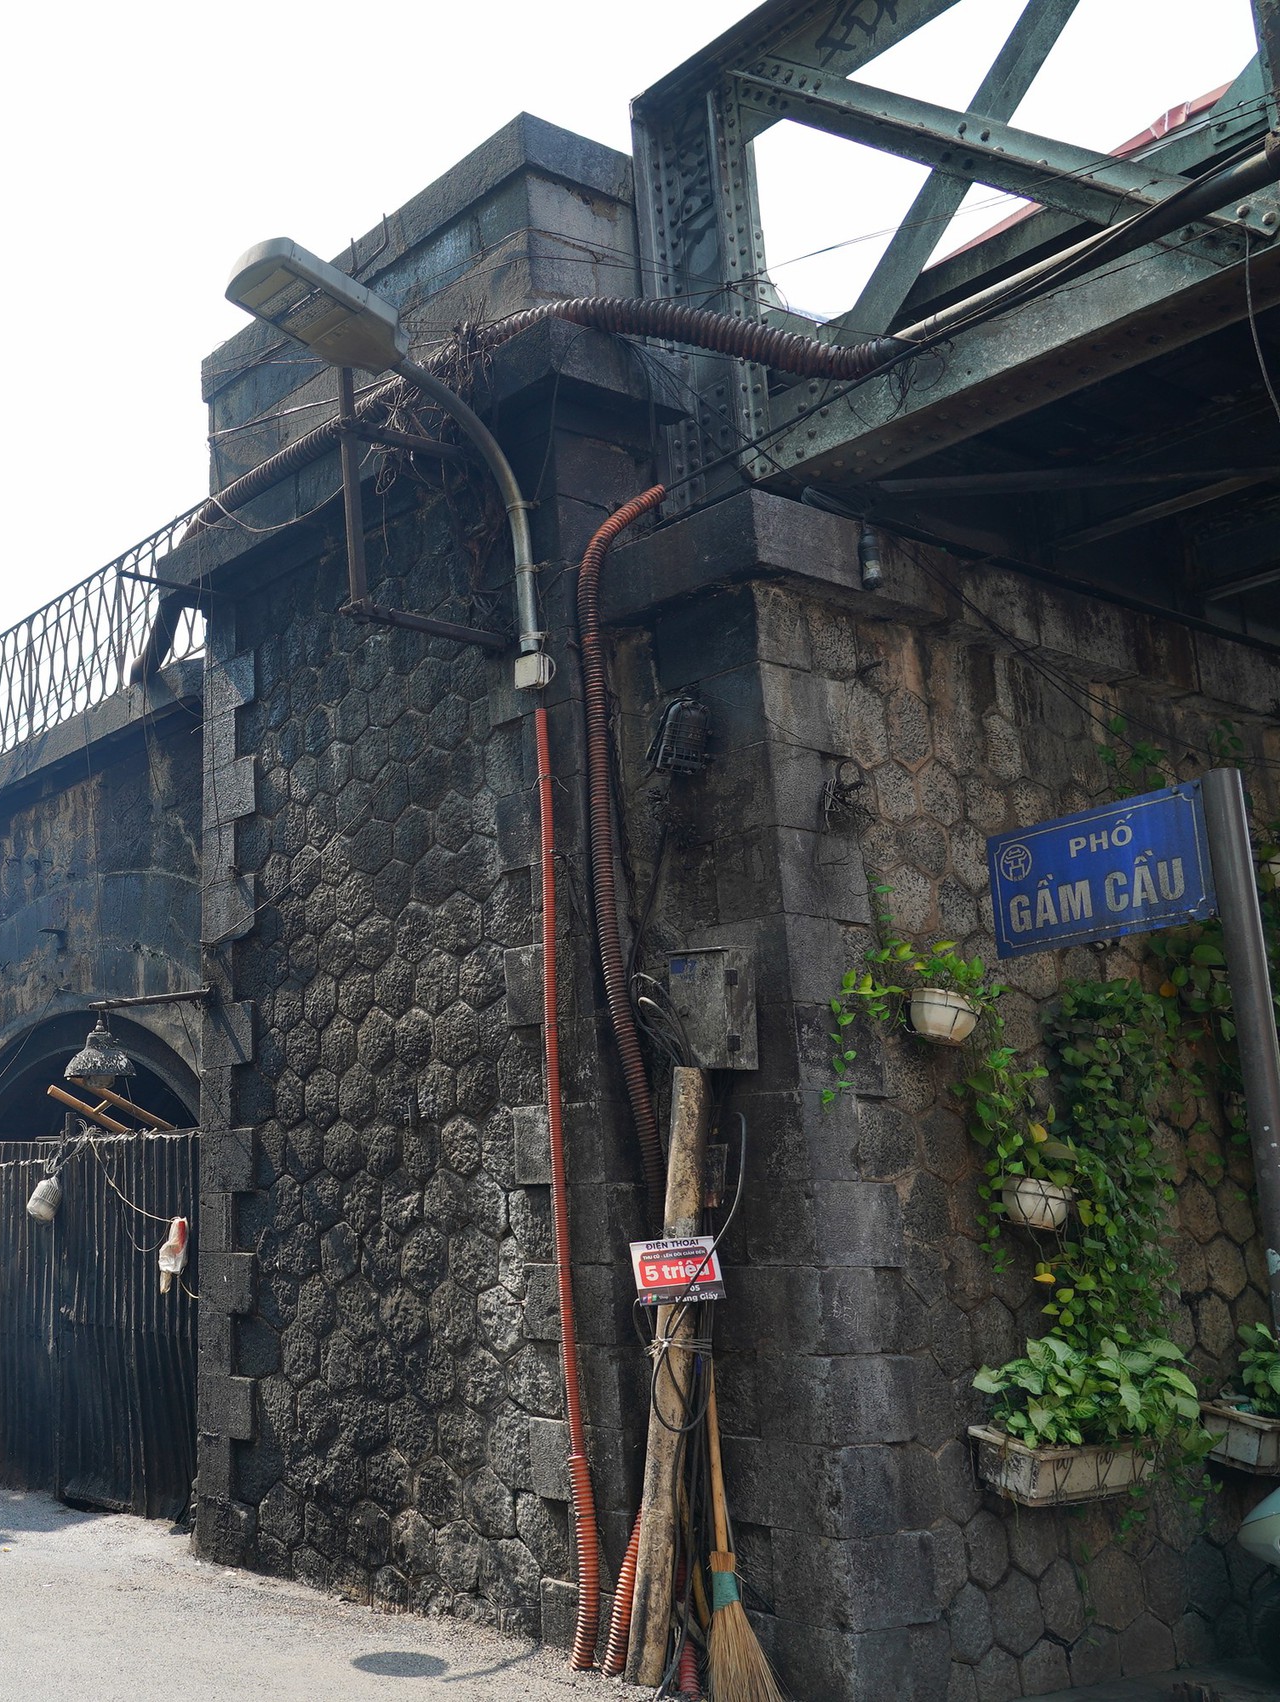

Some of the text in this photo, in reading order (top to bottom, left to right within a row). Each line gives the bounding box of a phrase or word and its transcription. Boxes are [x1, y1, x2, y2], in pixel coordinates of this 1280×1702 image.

[1069, 813, 1133, 858] PHỐ
[1009, 849, 1186, 933] GẦM CẦU
[645, 1239, 699, 1251] ĐIỆN THOẠI
[645, 1260, 710, 1281] 5 triệu
[690, 1284, 700, 1292] 05
